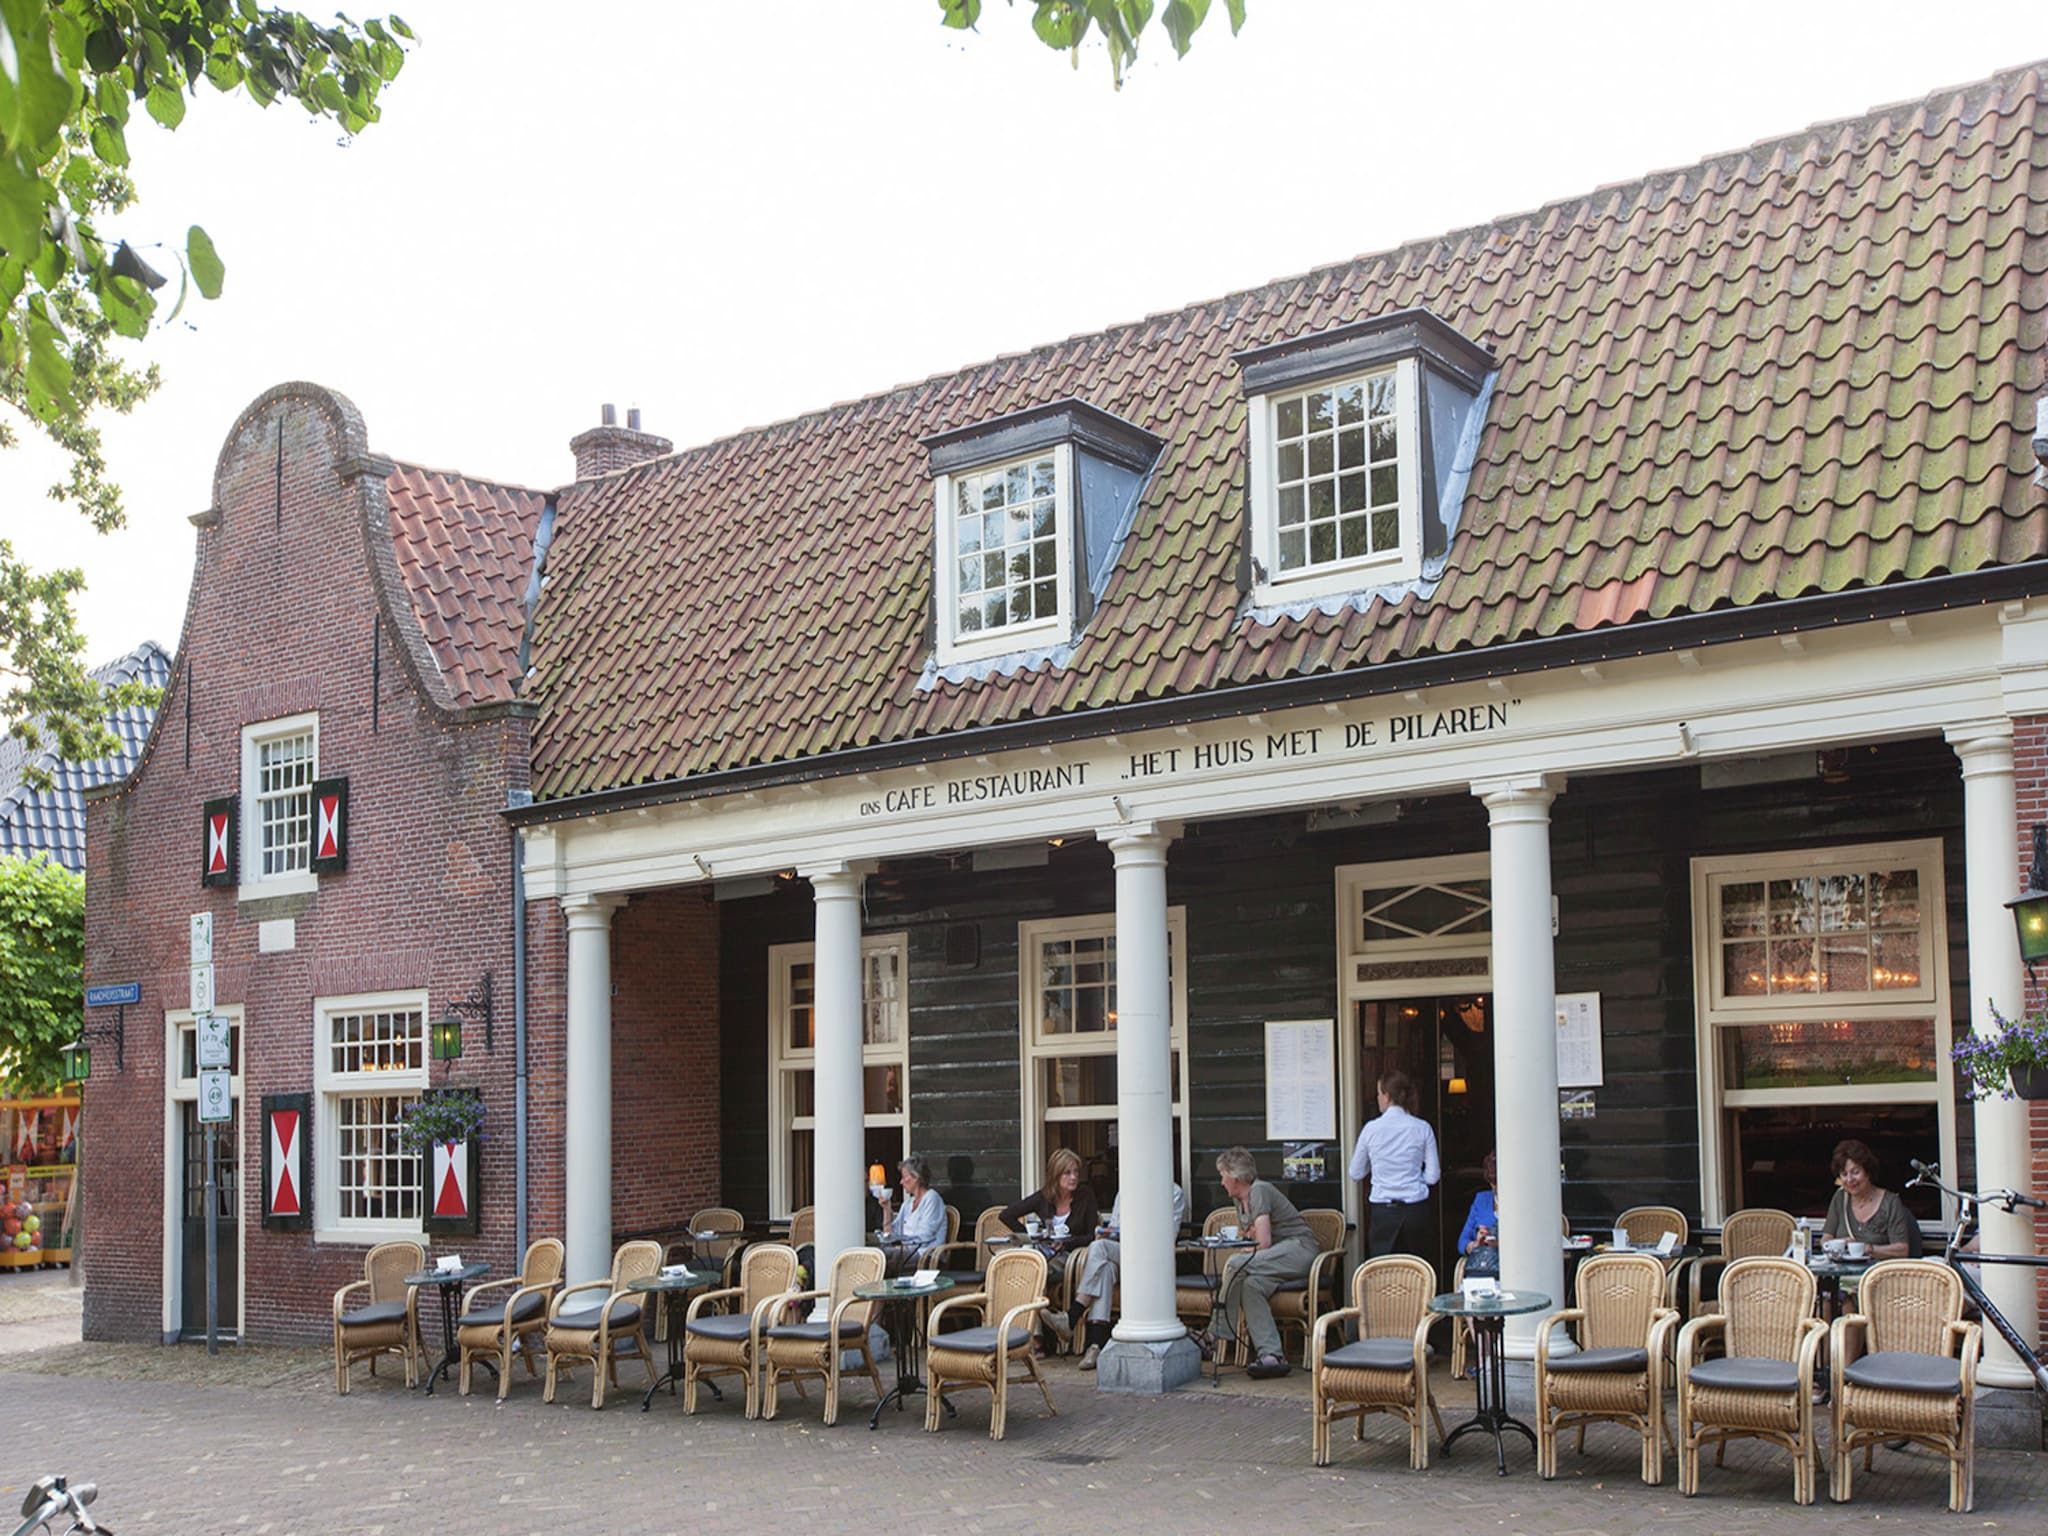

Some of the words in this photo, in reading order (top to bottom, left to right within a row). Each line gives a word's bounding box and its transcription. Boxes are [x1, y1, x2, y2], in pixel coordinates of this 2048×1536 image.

[860, 801, 882, 816] ONS
[885, 785, 936, 813] CAFE
[947, 762, 1091, 804] RESTAURANT
[1193, 738, 1254, 769] HUIS
[1266, 728, 1323, 759] MET
[1344, 721, 1377, 749] DE
